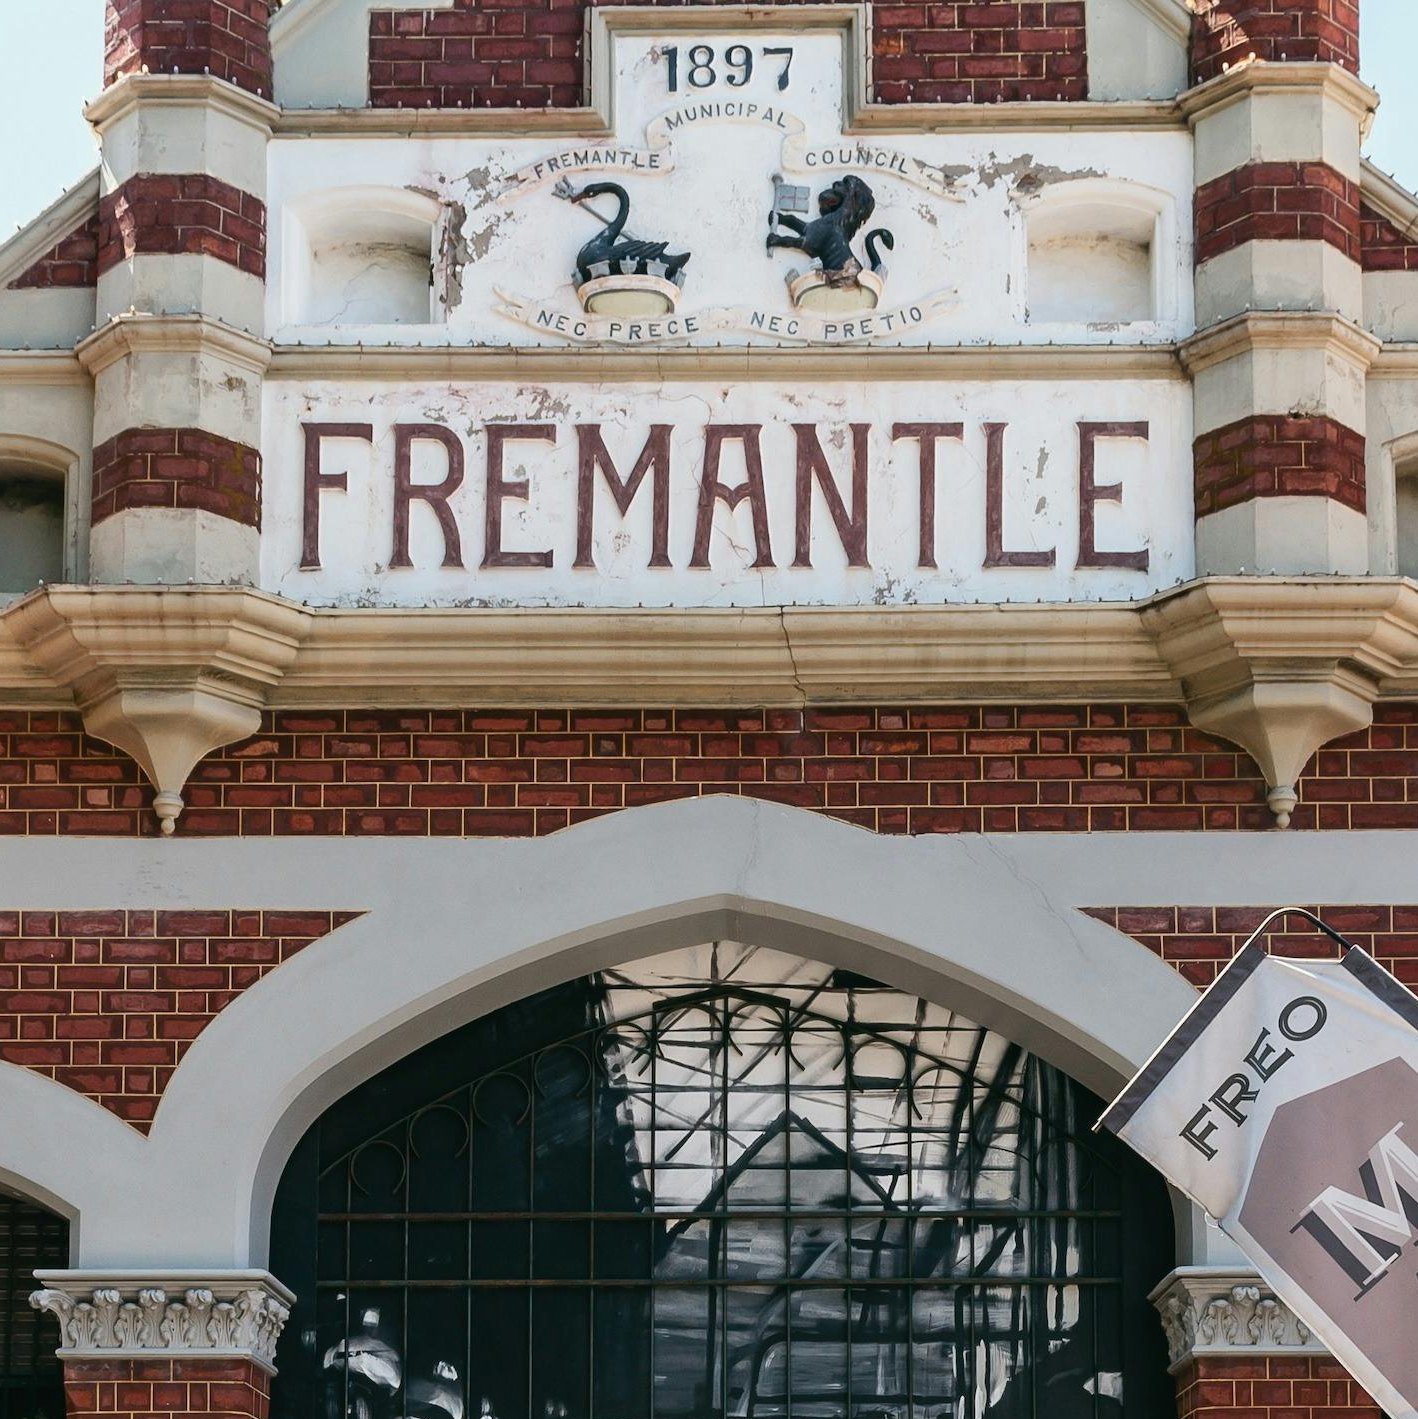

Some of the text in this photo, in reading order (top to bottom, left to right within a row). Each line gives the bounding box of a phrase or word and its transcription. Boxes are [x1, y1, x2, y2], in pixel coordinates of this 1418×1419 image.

[664, 45, 794, 92] 1897
[664, 103, 789, 132] MUNICIPAL
[534, 147, 662, 181] FREMANTLE
[805, 150, 911, 174] COUNCIL
[536, 309, 700, 342] NEC PRECE
[749, 305, 924, 341] NEC PRETIO
[299, 421, 1150, 571] FREMANTLE
[1177, 995, 1331, 1162] FREO
